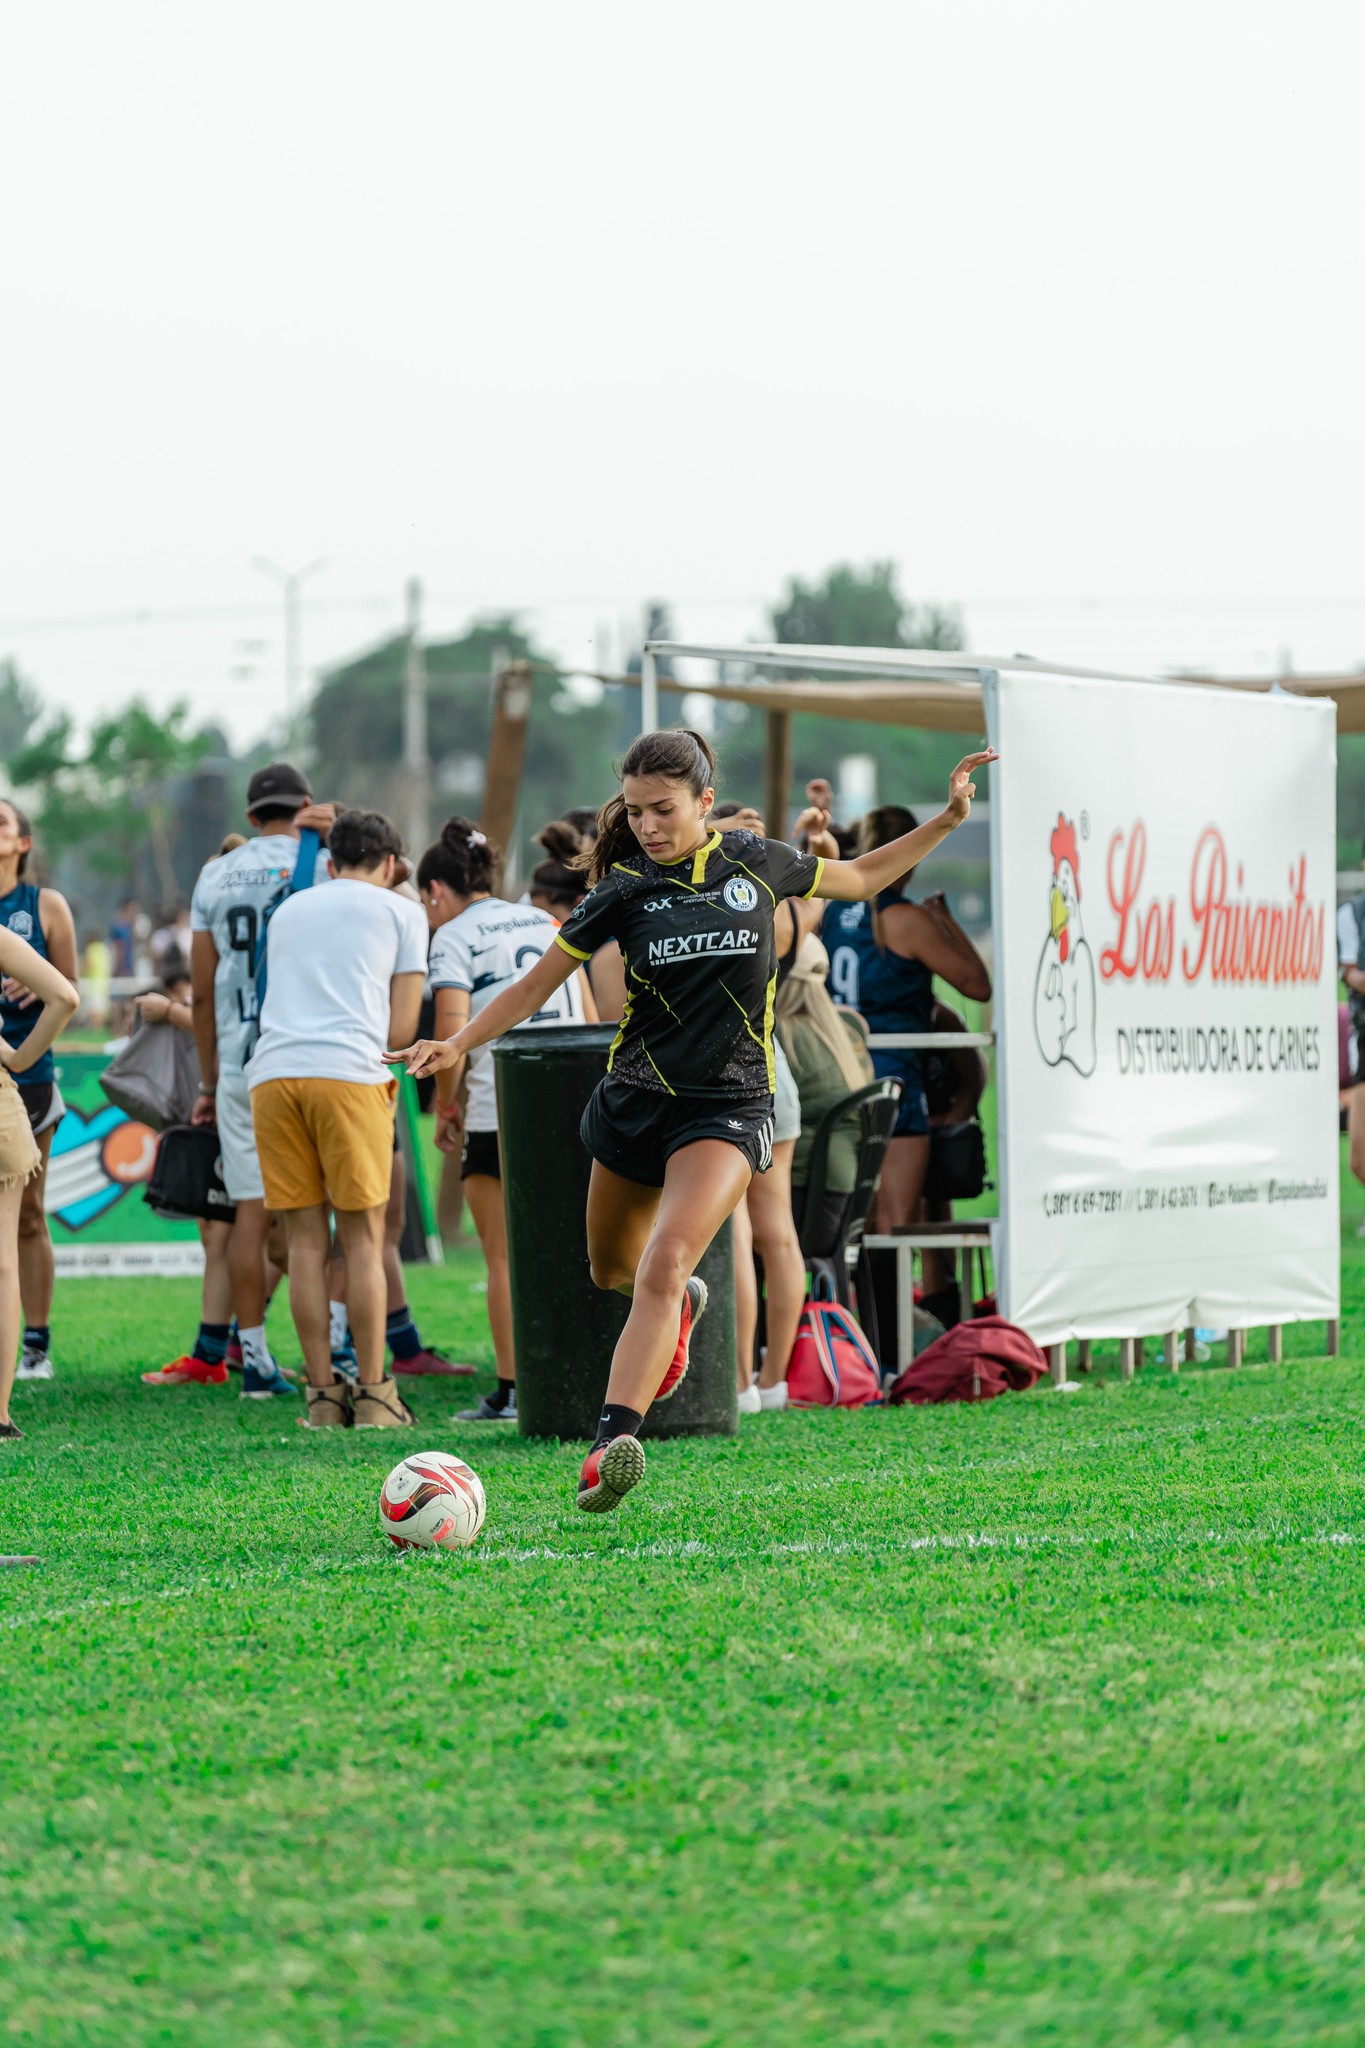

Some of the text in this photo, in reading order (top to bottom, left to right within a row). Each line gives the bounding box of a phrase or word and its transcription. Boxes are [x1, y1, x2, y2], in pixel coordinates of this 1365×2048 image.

[1101, 819, 1324, 984] Los Paisanitos
[1117, 1025, 1320, 1075] DISTRIBUIDORA DE CARNES
